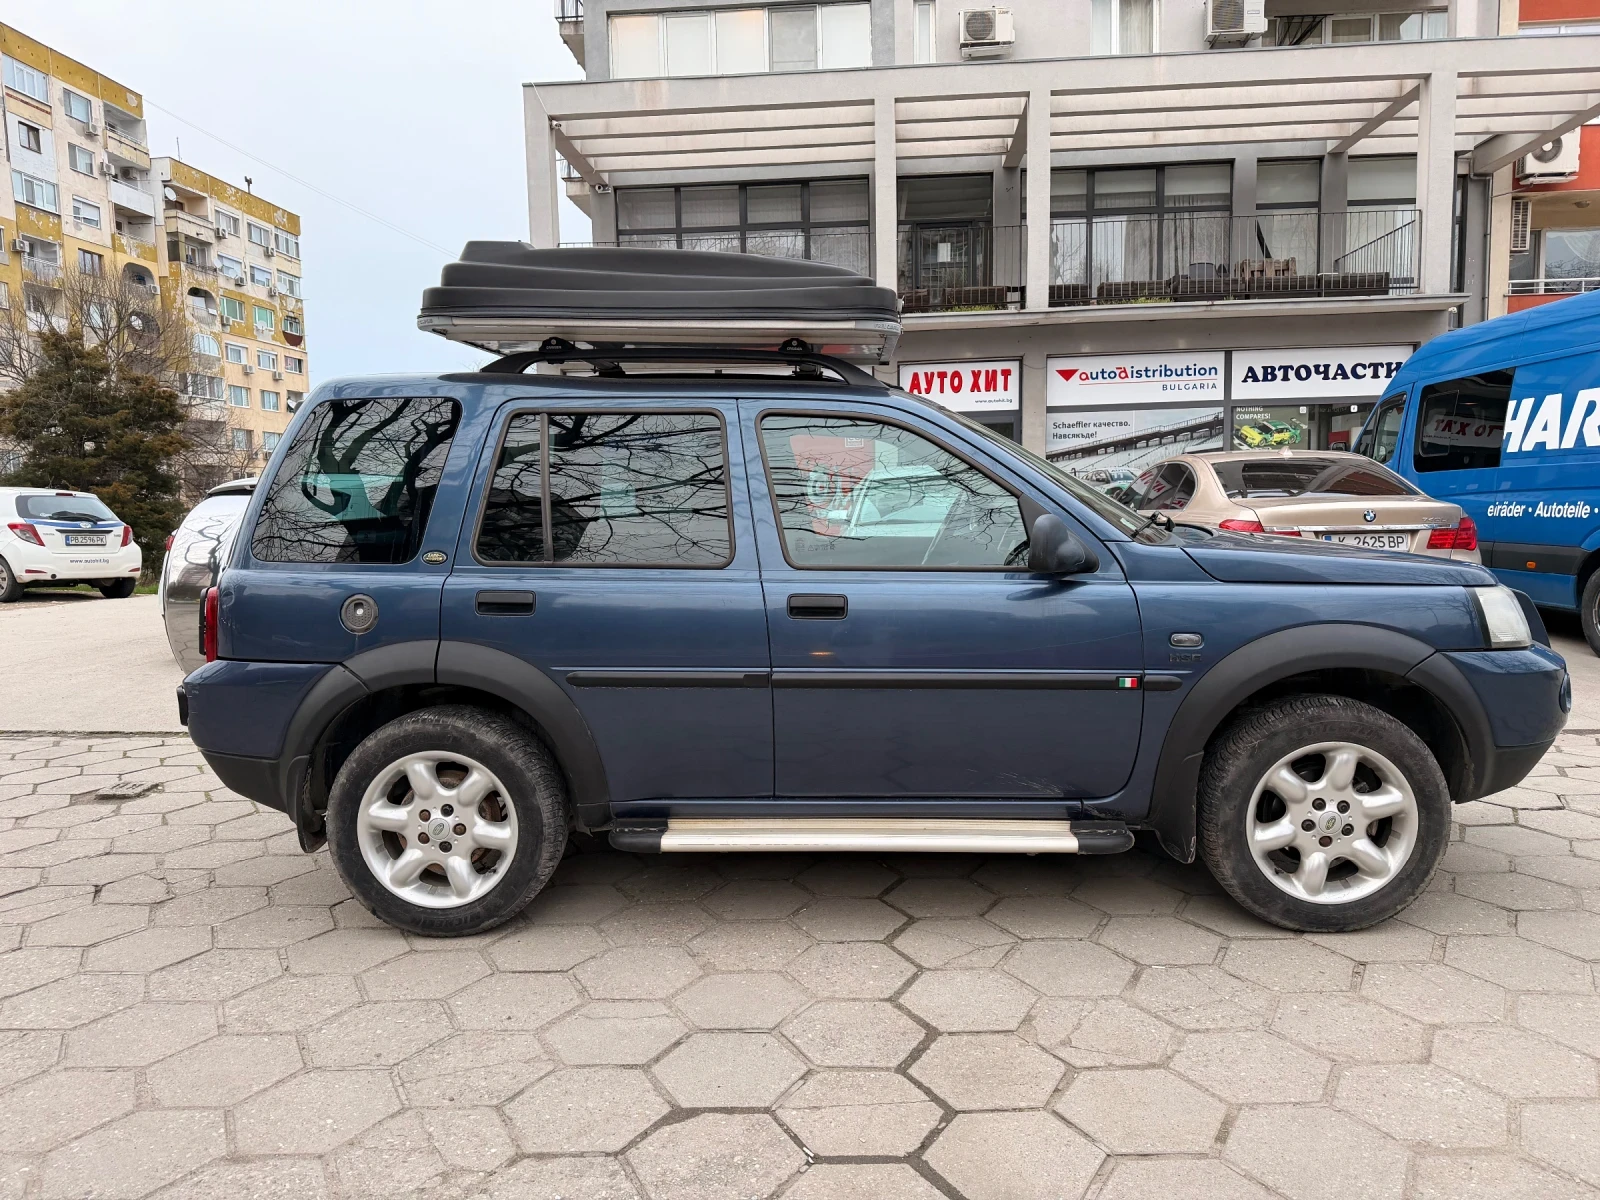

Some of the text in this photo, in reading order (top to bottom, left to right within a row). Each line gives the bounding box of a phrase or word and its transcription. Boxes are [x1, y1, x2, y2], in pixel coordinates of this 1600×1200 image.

[1079, 363, 1218, 382] autodistribution
[908, 368, 1012, 394] АУТО ХИТ
[1162, 382, 1217, 391] BULGARIA
[1052, 420, 1131, 430] Schaeffler качество.
[1052, 431, 1097, 440] Навсякъде!
[1487, 501, 1590, 519] eiräder Autoteile
[1388, 535, 1405, 548] BP
